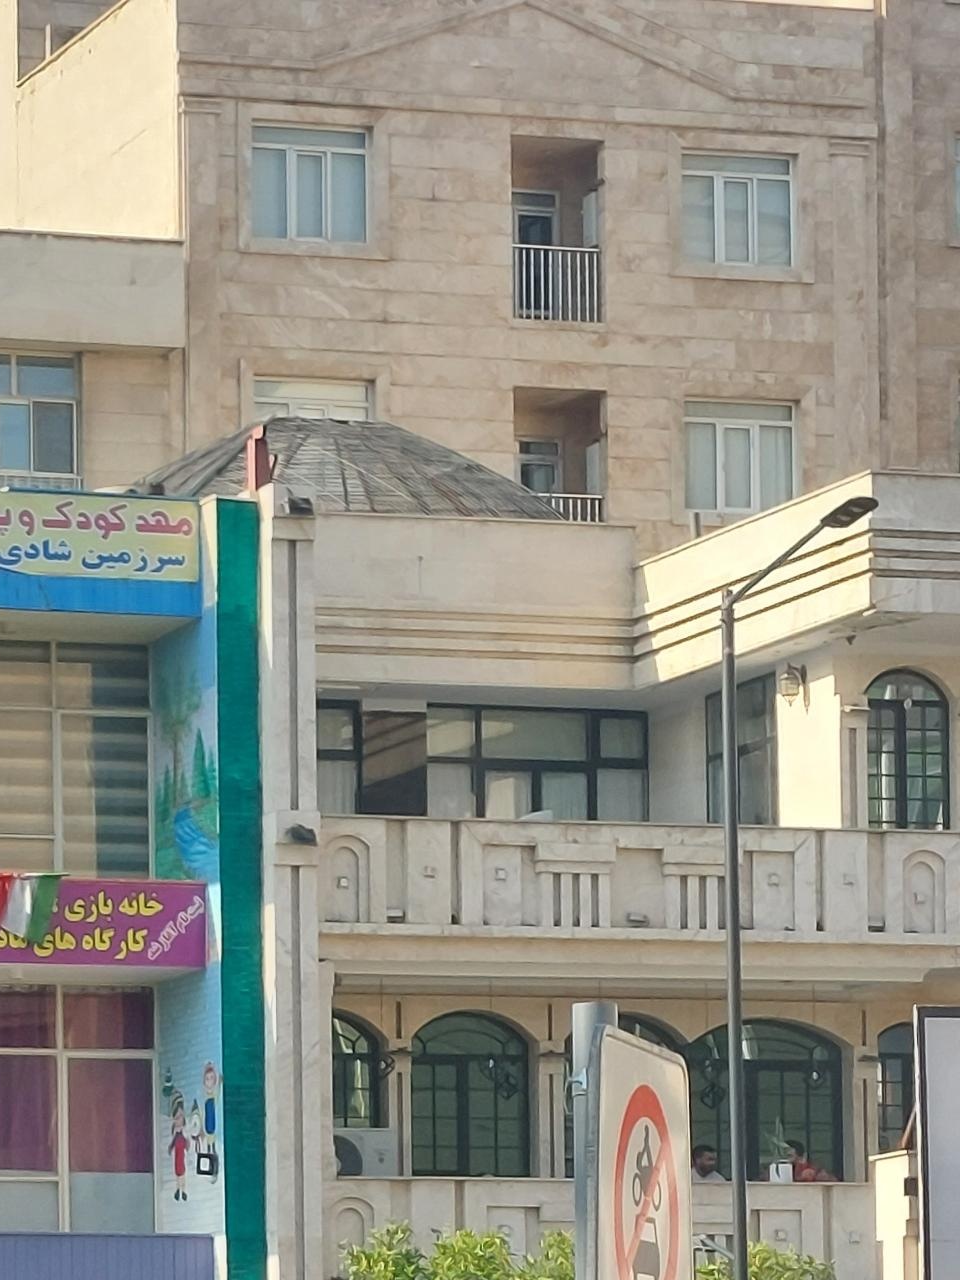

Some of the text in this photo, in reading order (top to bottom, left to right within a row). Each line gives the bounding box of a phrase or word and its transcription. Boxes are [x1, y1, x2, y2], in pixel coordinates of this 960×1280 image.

[18, 509, 35, 536] و
[42, 501, 128, 540] کودک
[135, 510, 193, 536] مهد
[81, 548, 186, 573] سرزمین
[119, 891, 164, 917] خانه
[33, 926, 76, 957] های
